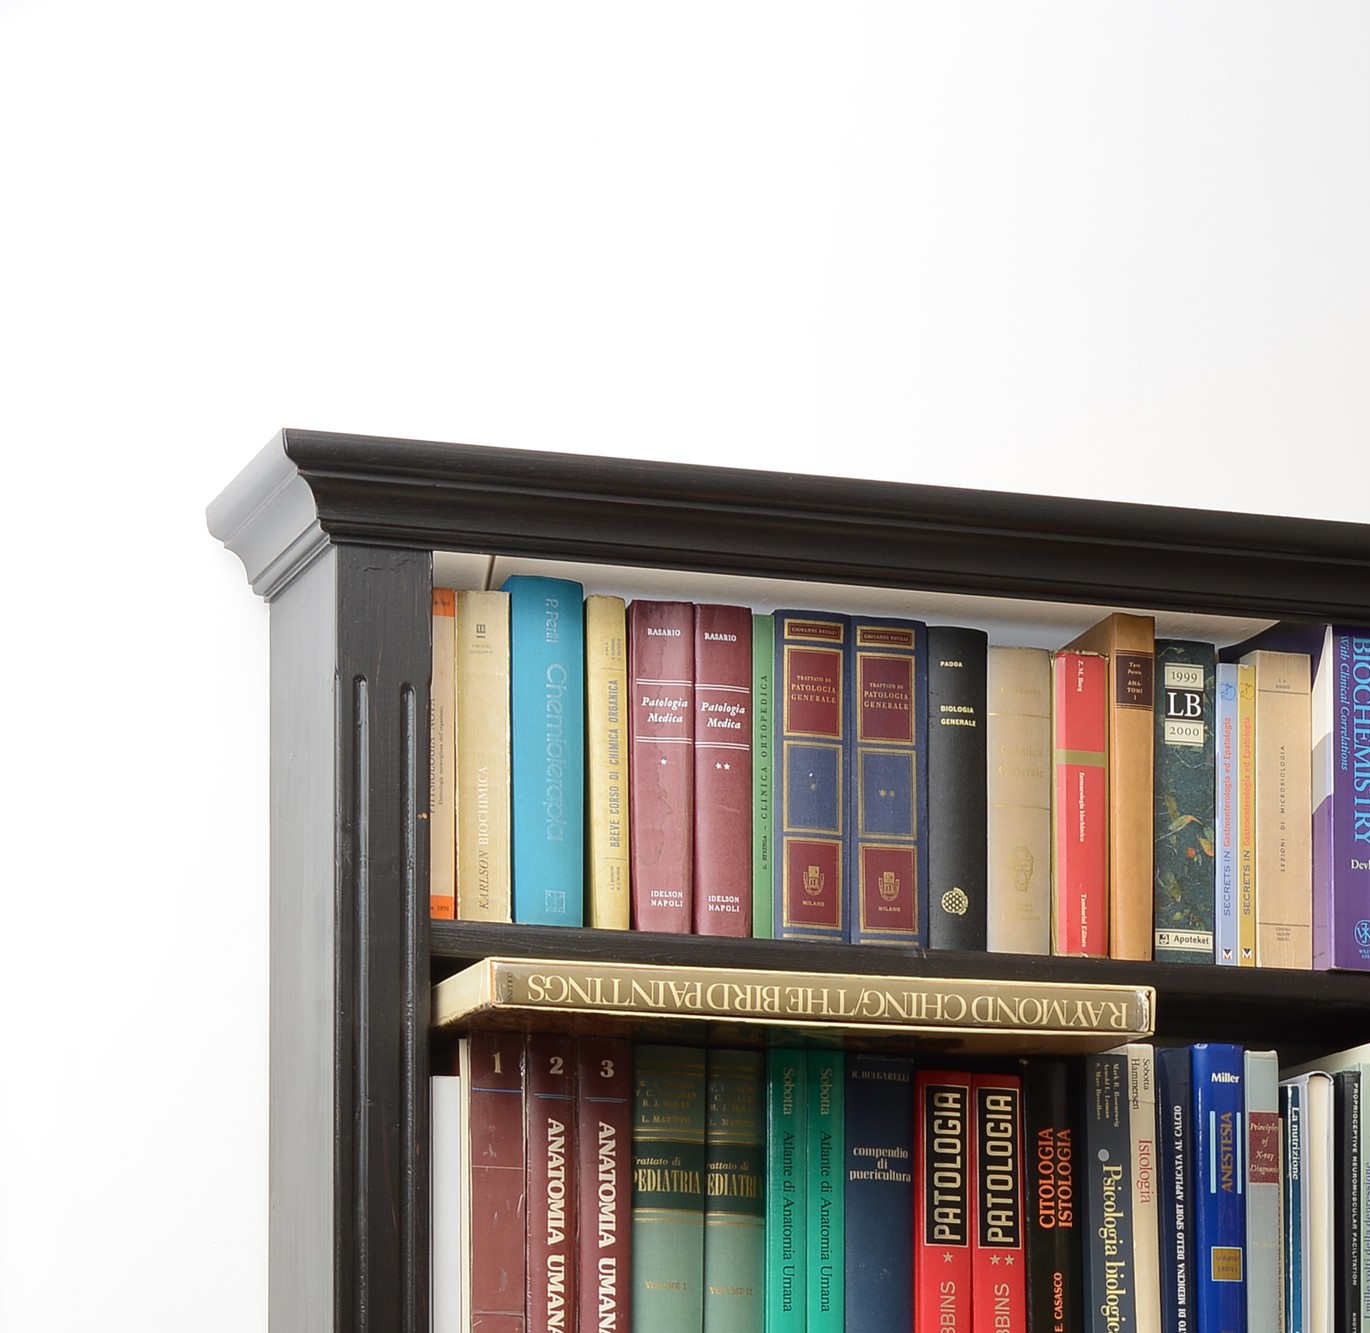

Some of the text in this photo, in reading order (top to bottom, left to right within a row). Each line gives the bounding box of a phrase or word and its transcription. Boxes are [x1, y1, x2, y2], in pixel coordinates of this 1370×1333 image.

[648, 628, 681, 637] RASARIO
[704, 632, 737, 643] RASARIO
[1171, 671, 1198, 683] 1999
[641, 696, 689, 711] Patologia
[700, 702, 746, 717] Patologia
[940, 705, 974, 714] BIOLOGIA
[1167, 692, 1202, 717] LB
[647, 712, 684, 724] Medica
[707, 718, 741, 730] Medica
[940, 718, 976, 727] GENERALE
[1169, 726, 1200, 738] 2000
[650, 890, 684, 899] IDELSON
[651, 899, 684, 908] NAPOLI
[1173, 934, 1210, 947] Apoteket
[528, 974, 703, 1007] PAINTINGS
[707, 982, 783, 1009] BIRD
[971, 997, 1128, 1029] RAYMOND
[550, 1056, 564, 1074] 2
[601, 1060, 614, 1077] 3
[1211, 1072, 1240, 1084] Miller
[853, 1146, 908, 1161] compendio
[1220, 1111, 1233, 1193] ANESTESIA
[878, 1159, 888, 1170] di
[933, 1091, 962, 1242] PATOLOGIA
[547, 1117, 565, 1246] ANATOMIA
[849, 1169, 911, 1182] puericultura
[1038, 1128, 1055, 1229] CITOLOGIA
[1057, 1129, 1073, 1228] ISTOLOGIA
[599, 1121, 616, 1249] ANATOMIA
[1099, 1164, 1124, 1255] Psicologia
